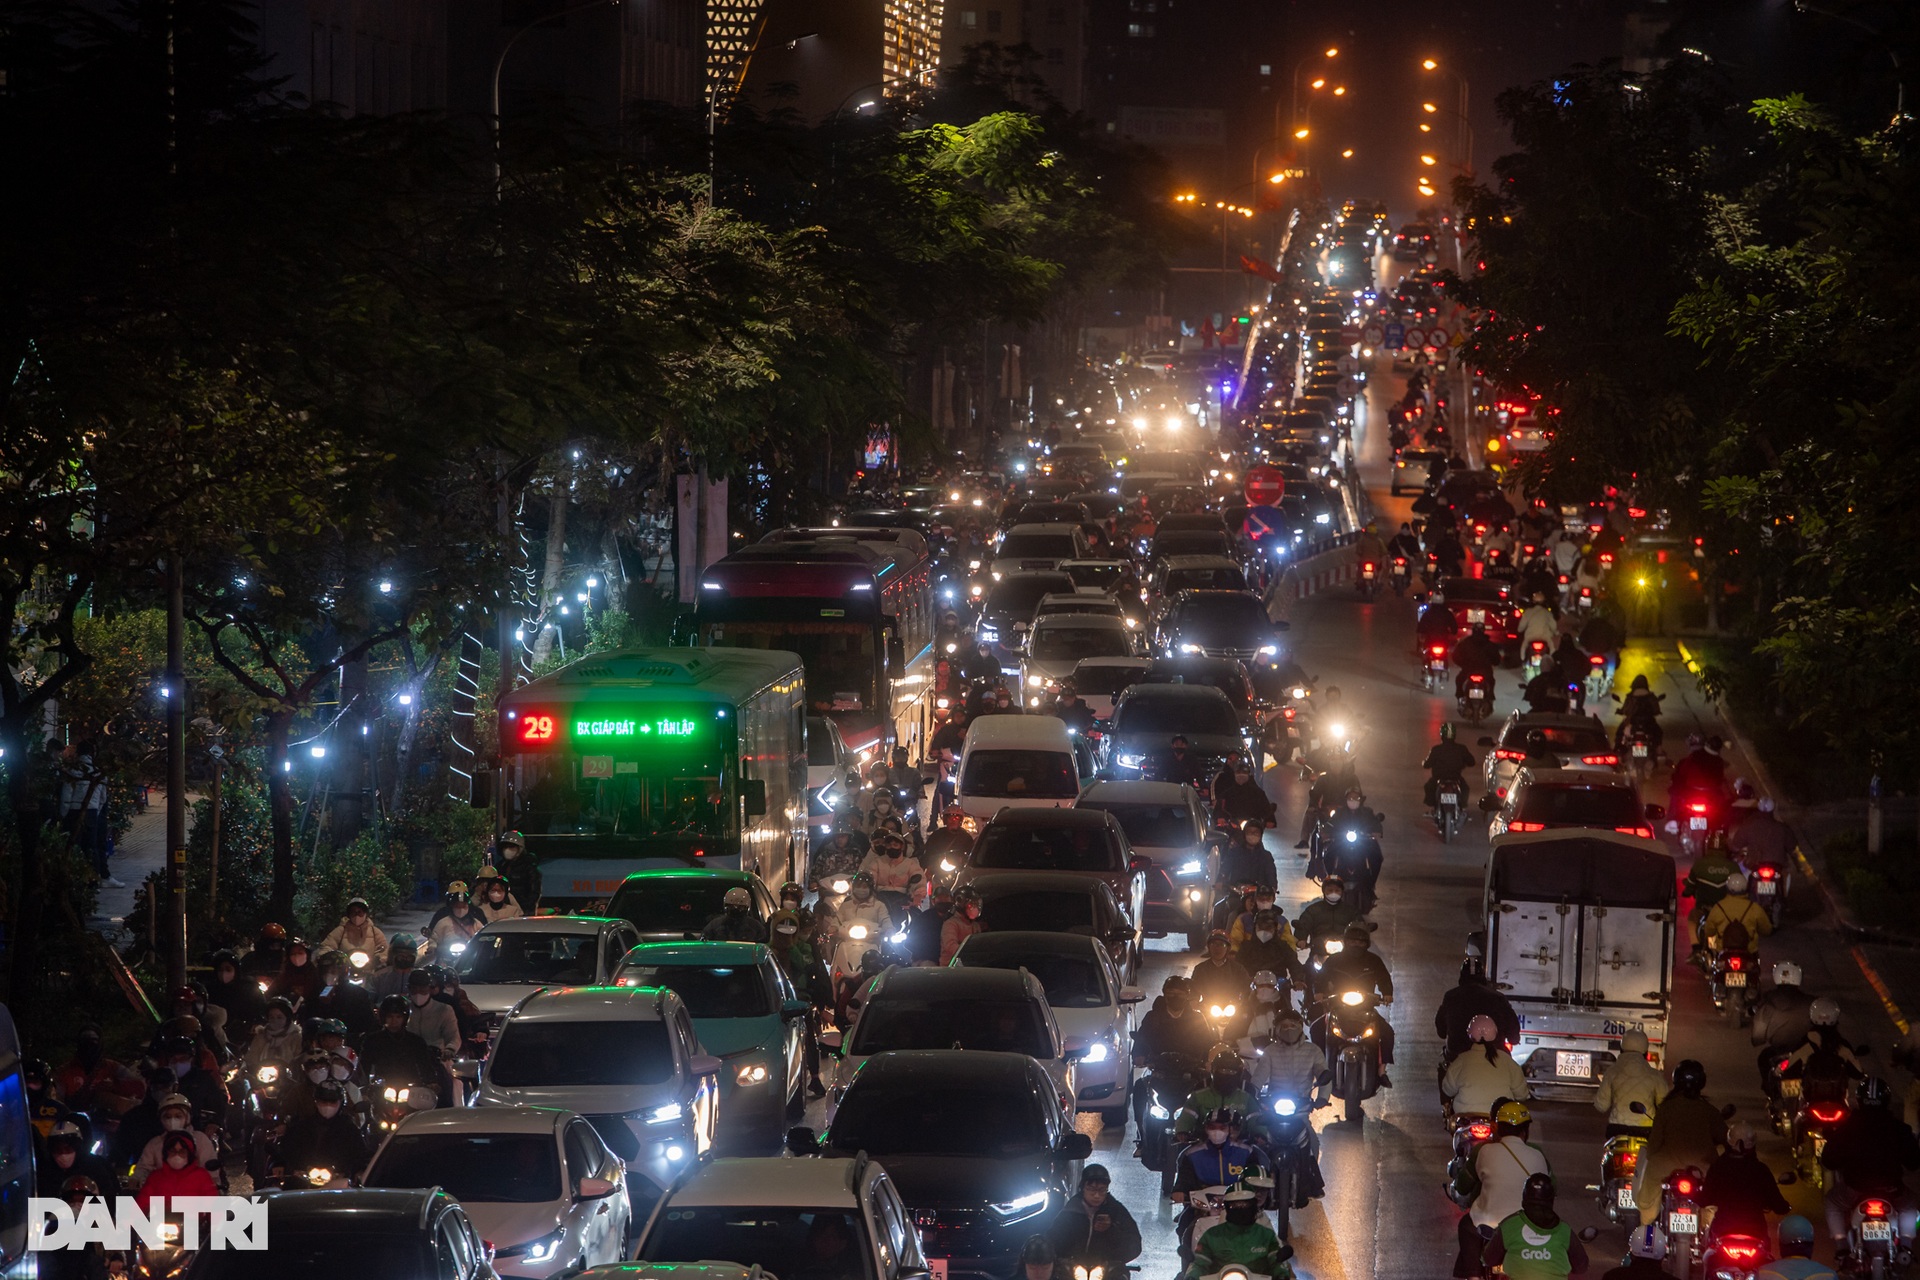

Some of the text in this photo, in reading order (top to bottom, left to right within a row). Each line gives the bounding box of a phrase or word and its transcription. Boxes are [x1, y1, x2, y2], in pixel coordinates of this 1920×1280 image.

[525, 716, 552, 738] 29
[577, 718, 695, 737] BX GIÁP BÁT TÂN LẬP
[588, 760, 607, 774] 29
[1707, 865, 1729, 875] Grab
[1603, 1020, 1644, 1035] 26670
[1558, 1065, 1590, 1077] 266.70
[40, 1105, 57, 1116] be
[1228, 1162, 1243, 1175] be
[1250, 1246, 1267, 1254] Grab
[1521, 1248, 1552, 1260] Grab
